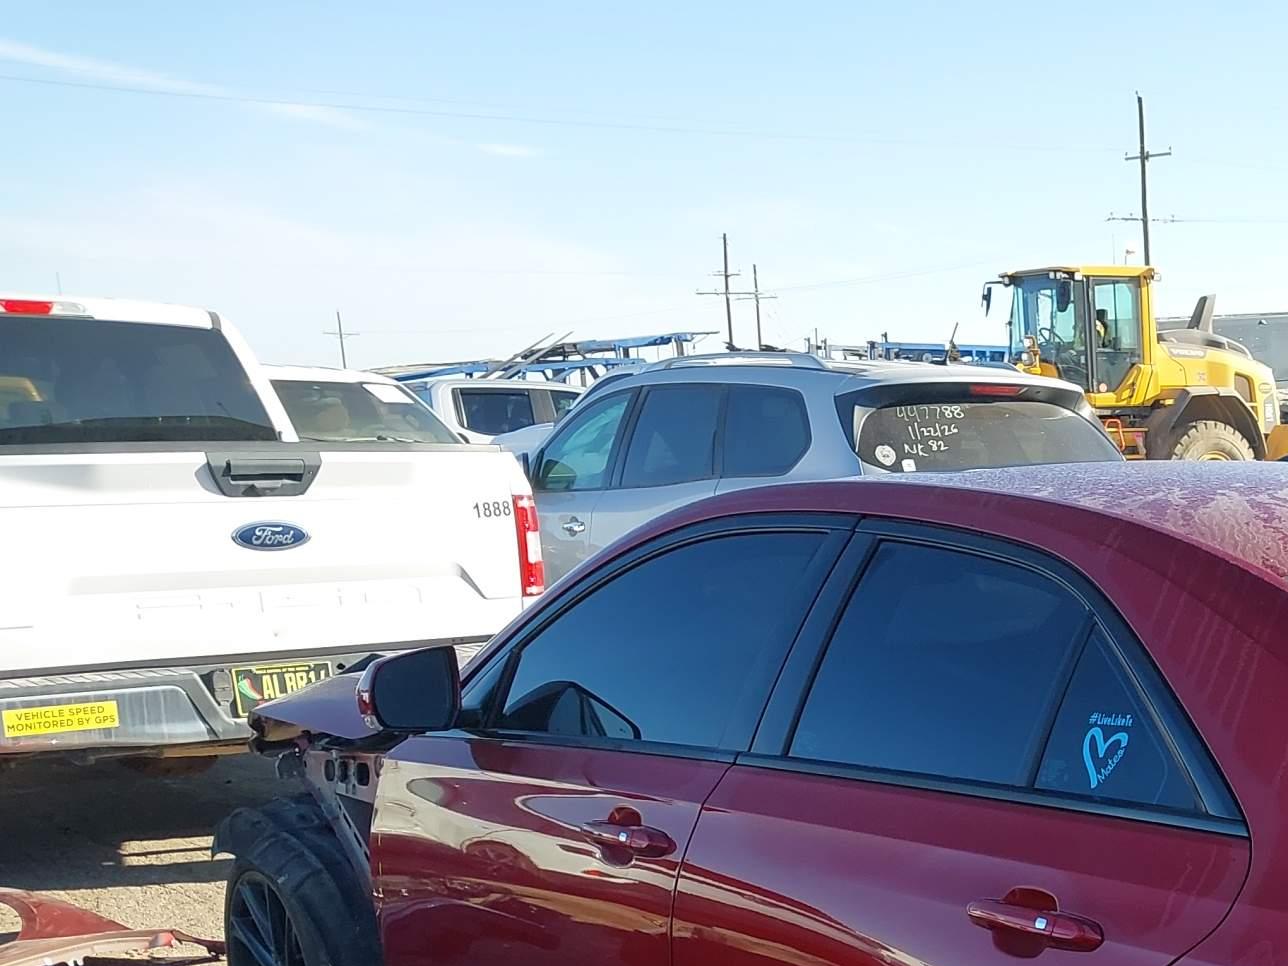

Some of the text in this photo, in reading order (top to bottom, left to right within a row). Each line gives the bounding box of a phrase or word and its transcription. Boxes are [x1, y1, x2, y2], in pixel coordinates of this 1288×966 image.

[908, 422, 958, 440] 1/22/26
[928, 439, 949, 451] 82
[472, 500, 512, 519] 1888
[251, 526, 295, 545] Ford
[16, 705, 105, 721] VEHICLE SPEED
[7, 715, 116, 733] MONITORED BY GPS
